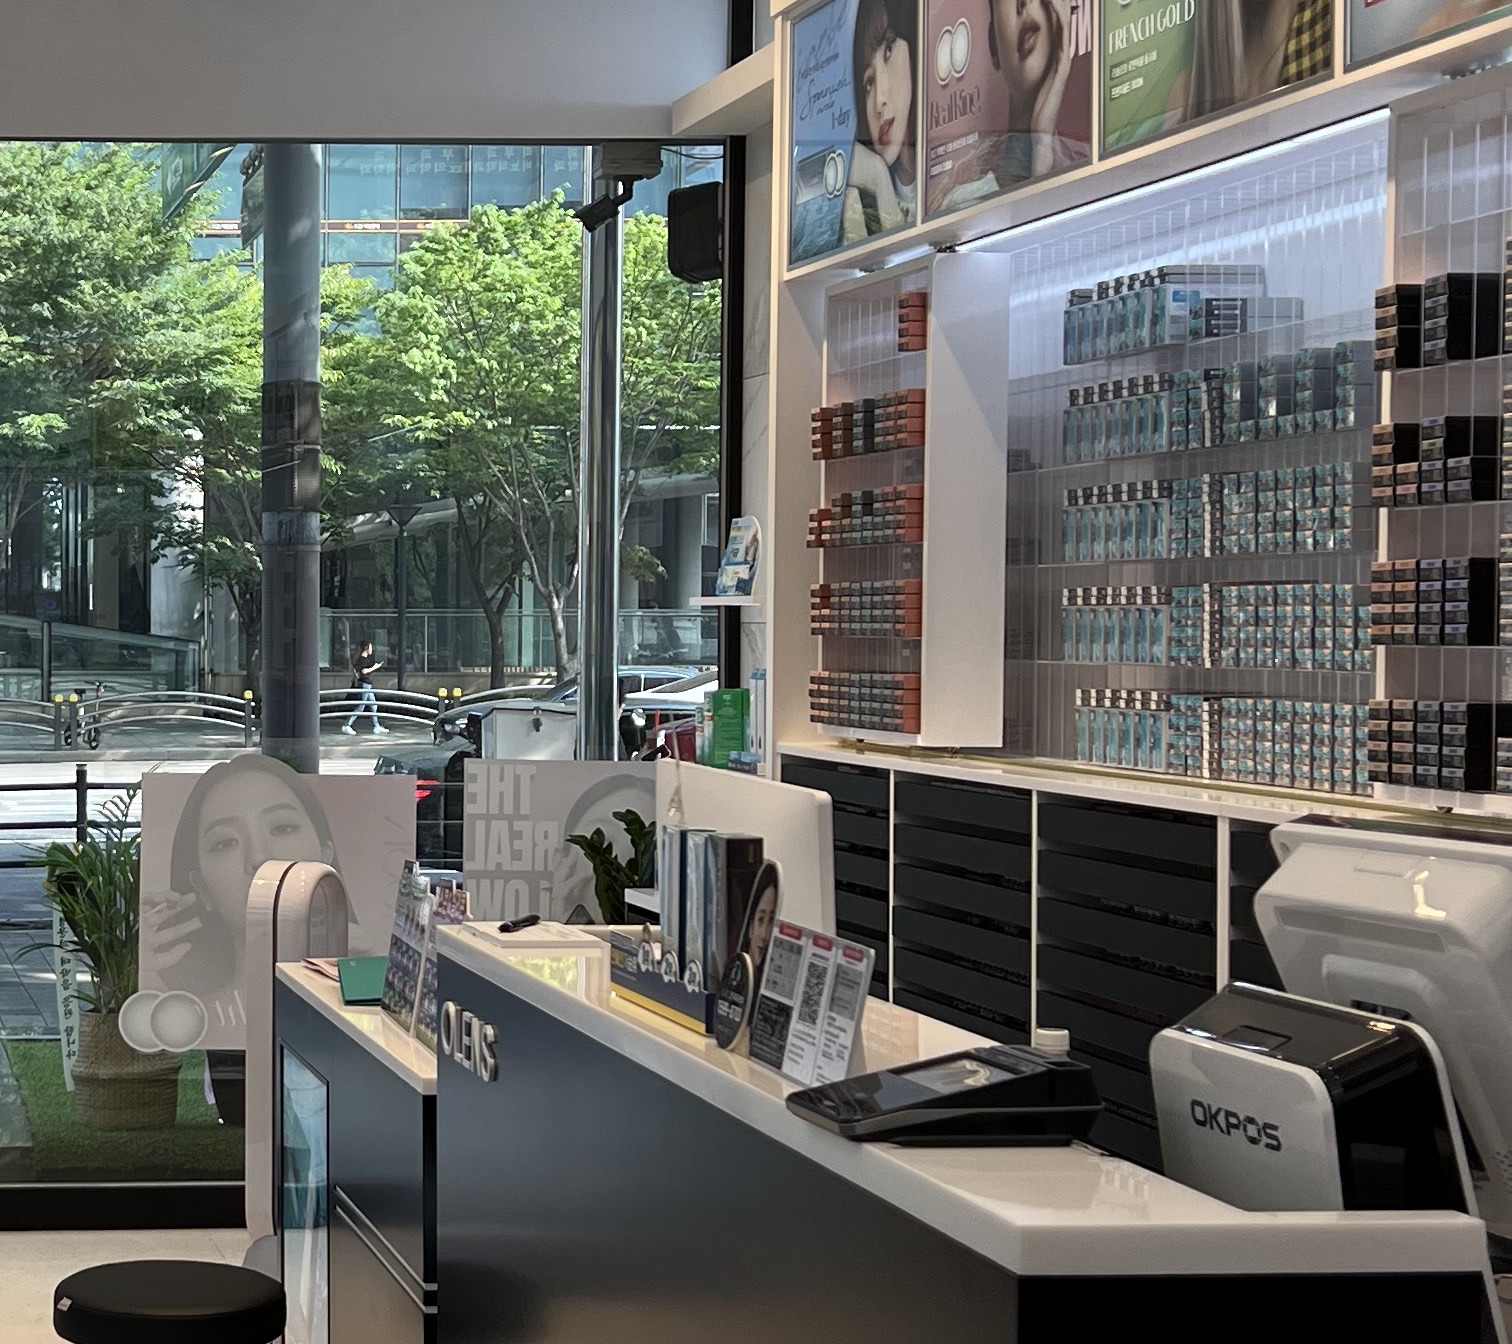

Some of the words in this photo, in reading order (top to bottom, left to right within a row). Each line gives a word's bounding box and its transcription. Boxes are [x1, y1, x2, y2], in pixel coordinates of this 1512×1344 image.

[1108, 13, 1155, 54] FRENCH
[440, 1000, 498, 1082] OLENS
[1191, 1099, 1282, 1152] OKPOS
